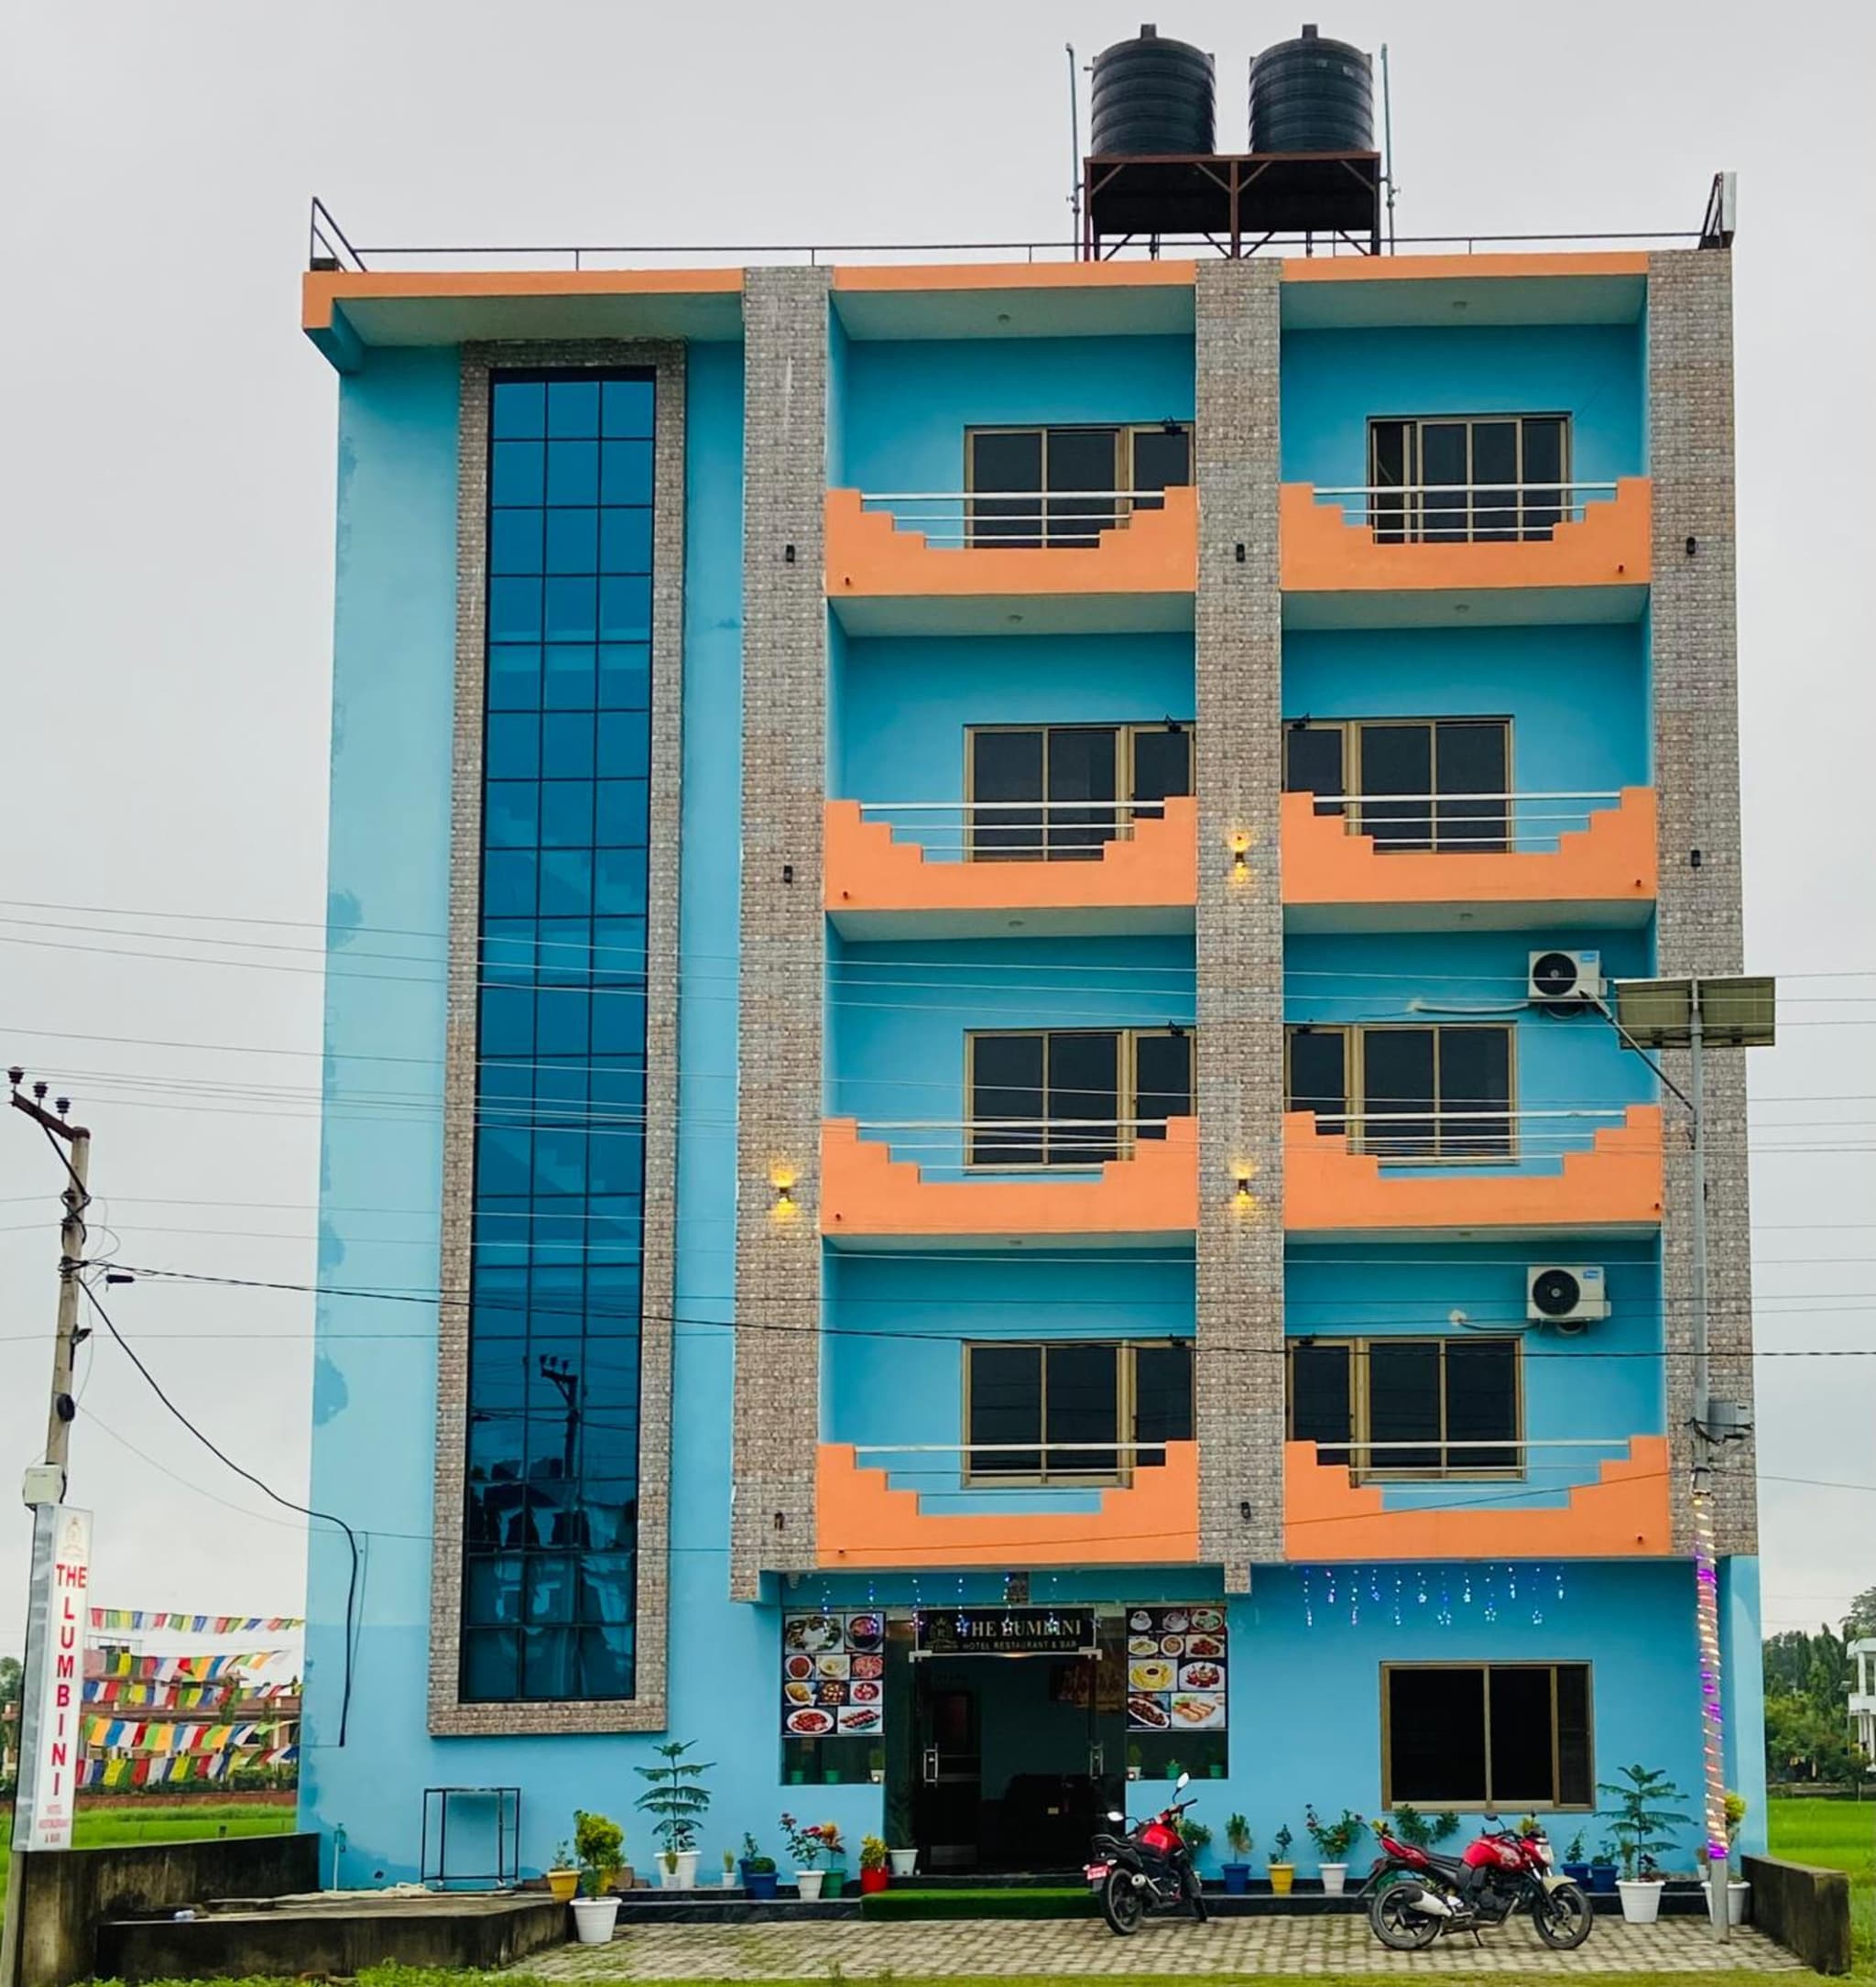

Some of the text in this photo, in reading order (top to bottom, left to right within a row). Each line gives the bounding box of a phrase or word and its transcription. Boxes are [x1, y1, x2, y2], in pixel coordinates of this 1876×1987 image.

[56, 1564, 87, 1589] THE
[959, 1621, 997, 1637] HE
[51, 1597, 75, 1796] LUMBINI
